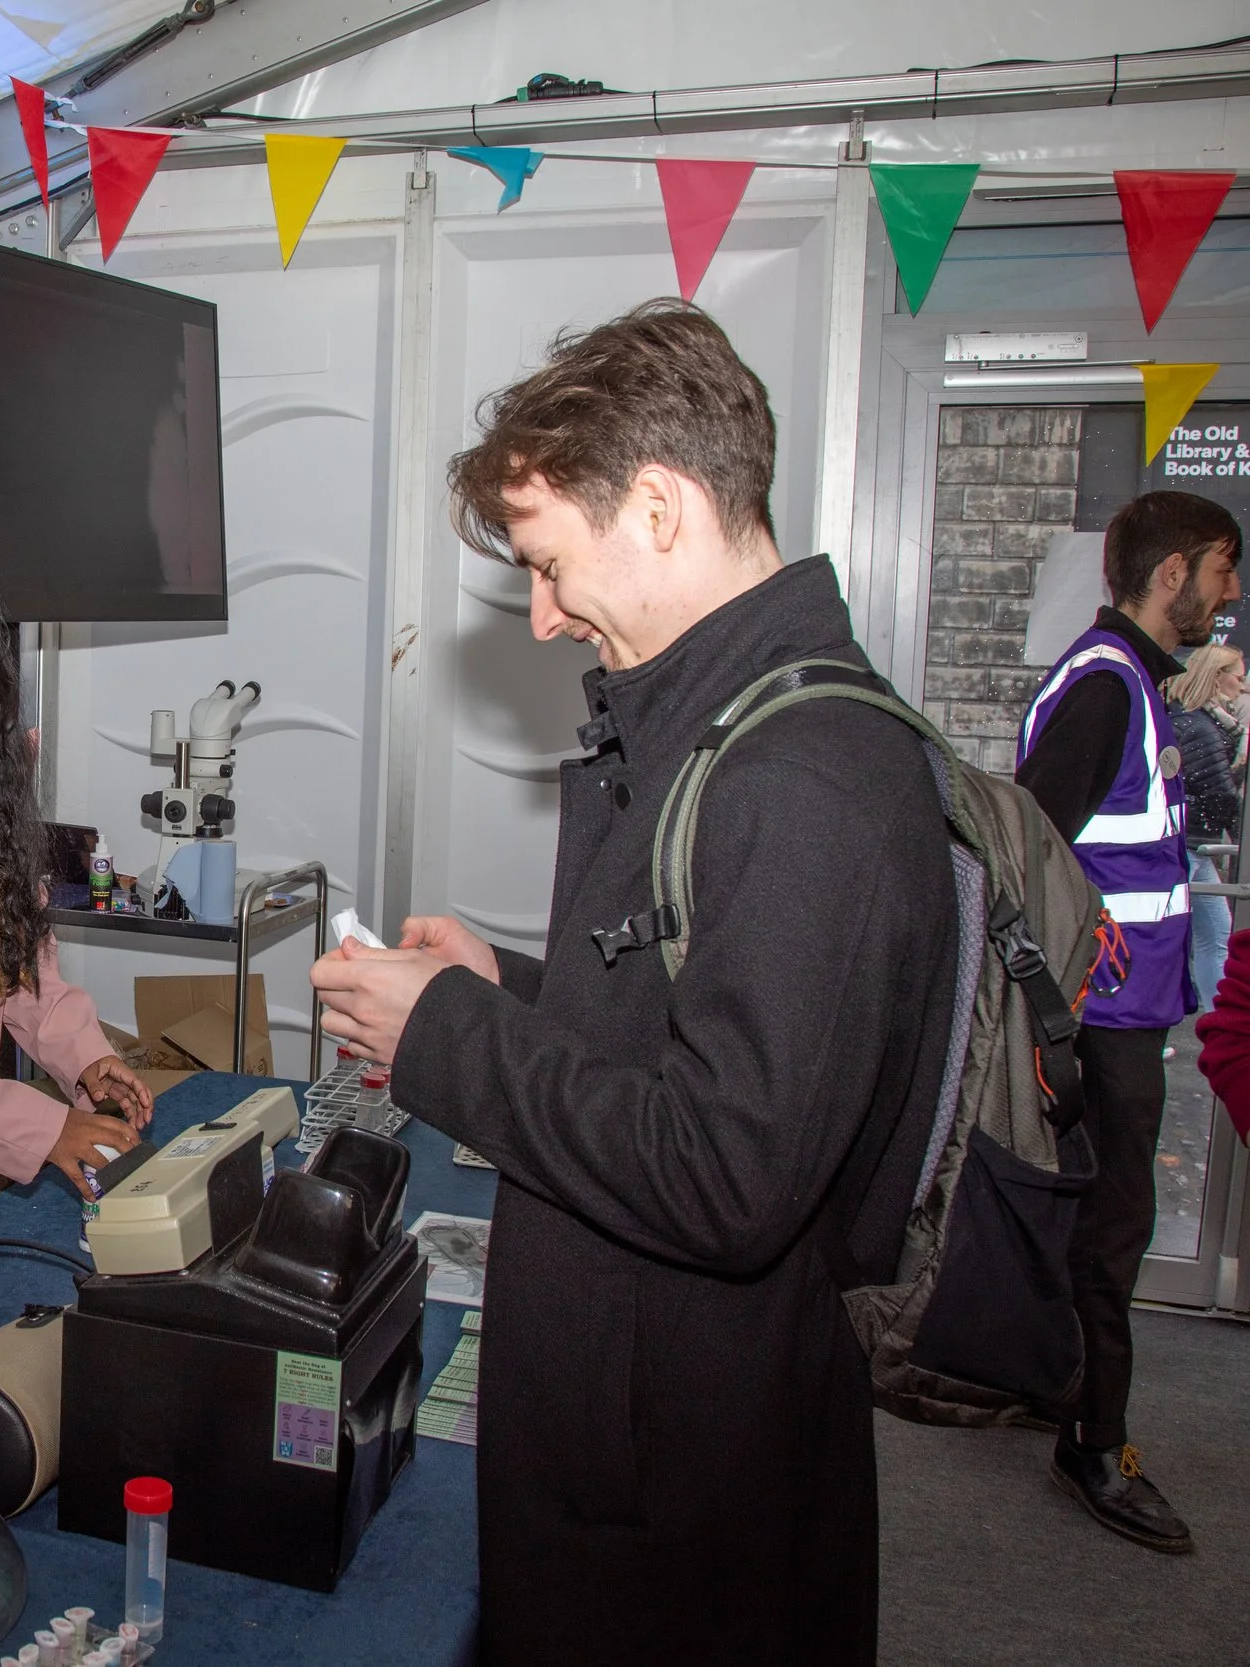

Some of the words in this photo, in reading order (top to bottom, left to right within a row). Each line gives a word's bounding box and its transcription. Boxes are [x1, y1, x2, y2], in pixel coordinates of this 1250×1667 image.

[1204, 425, 1239, 441] Old
[1165, 444, 1232, 462] Library
[1235, 443, 1250, 458] &
[1165, 461, 1213, 476] Book
[1215, 461, 1236, 476] of
[290, 1369, 310, 1377] RIGHT
[312, 1372, 334, 1381] RULES
